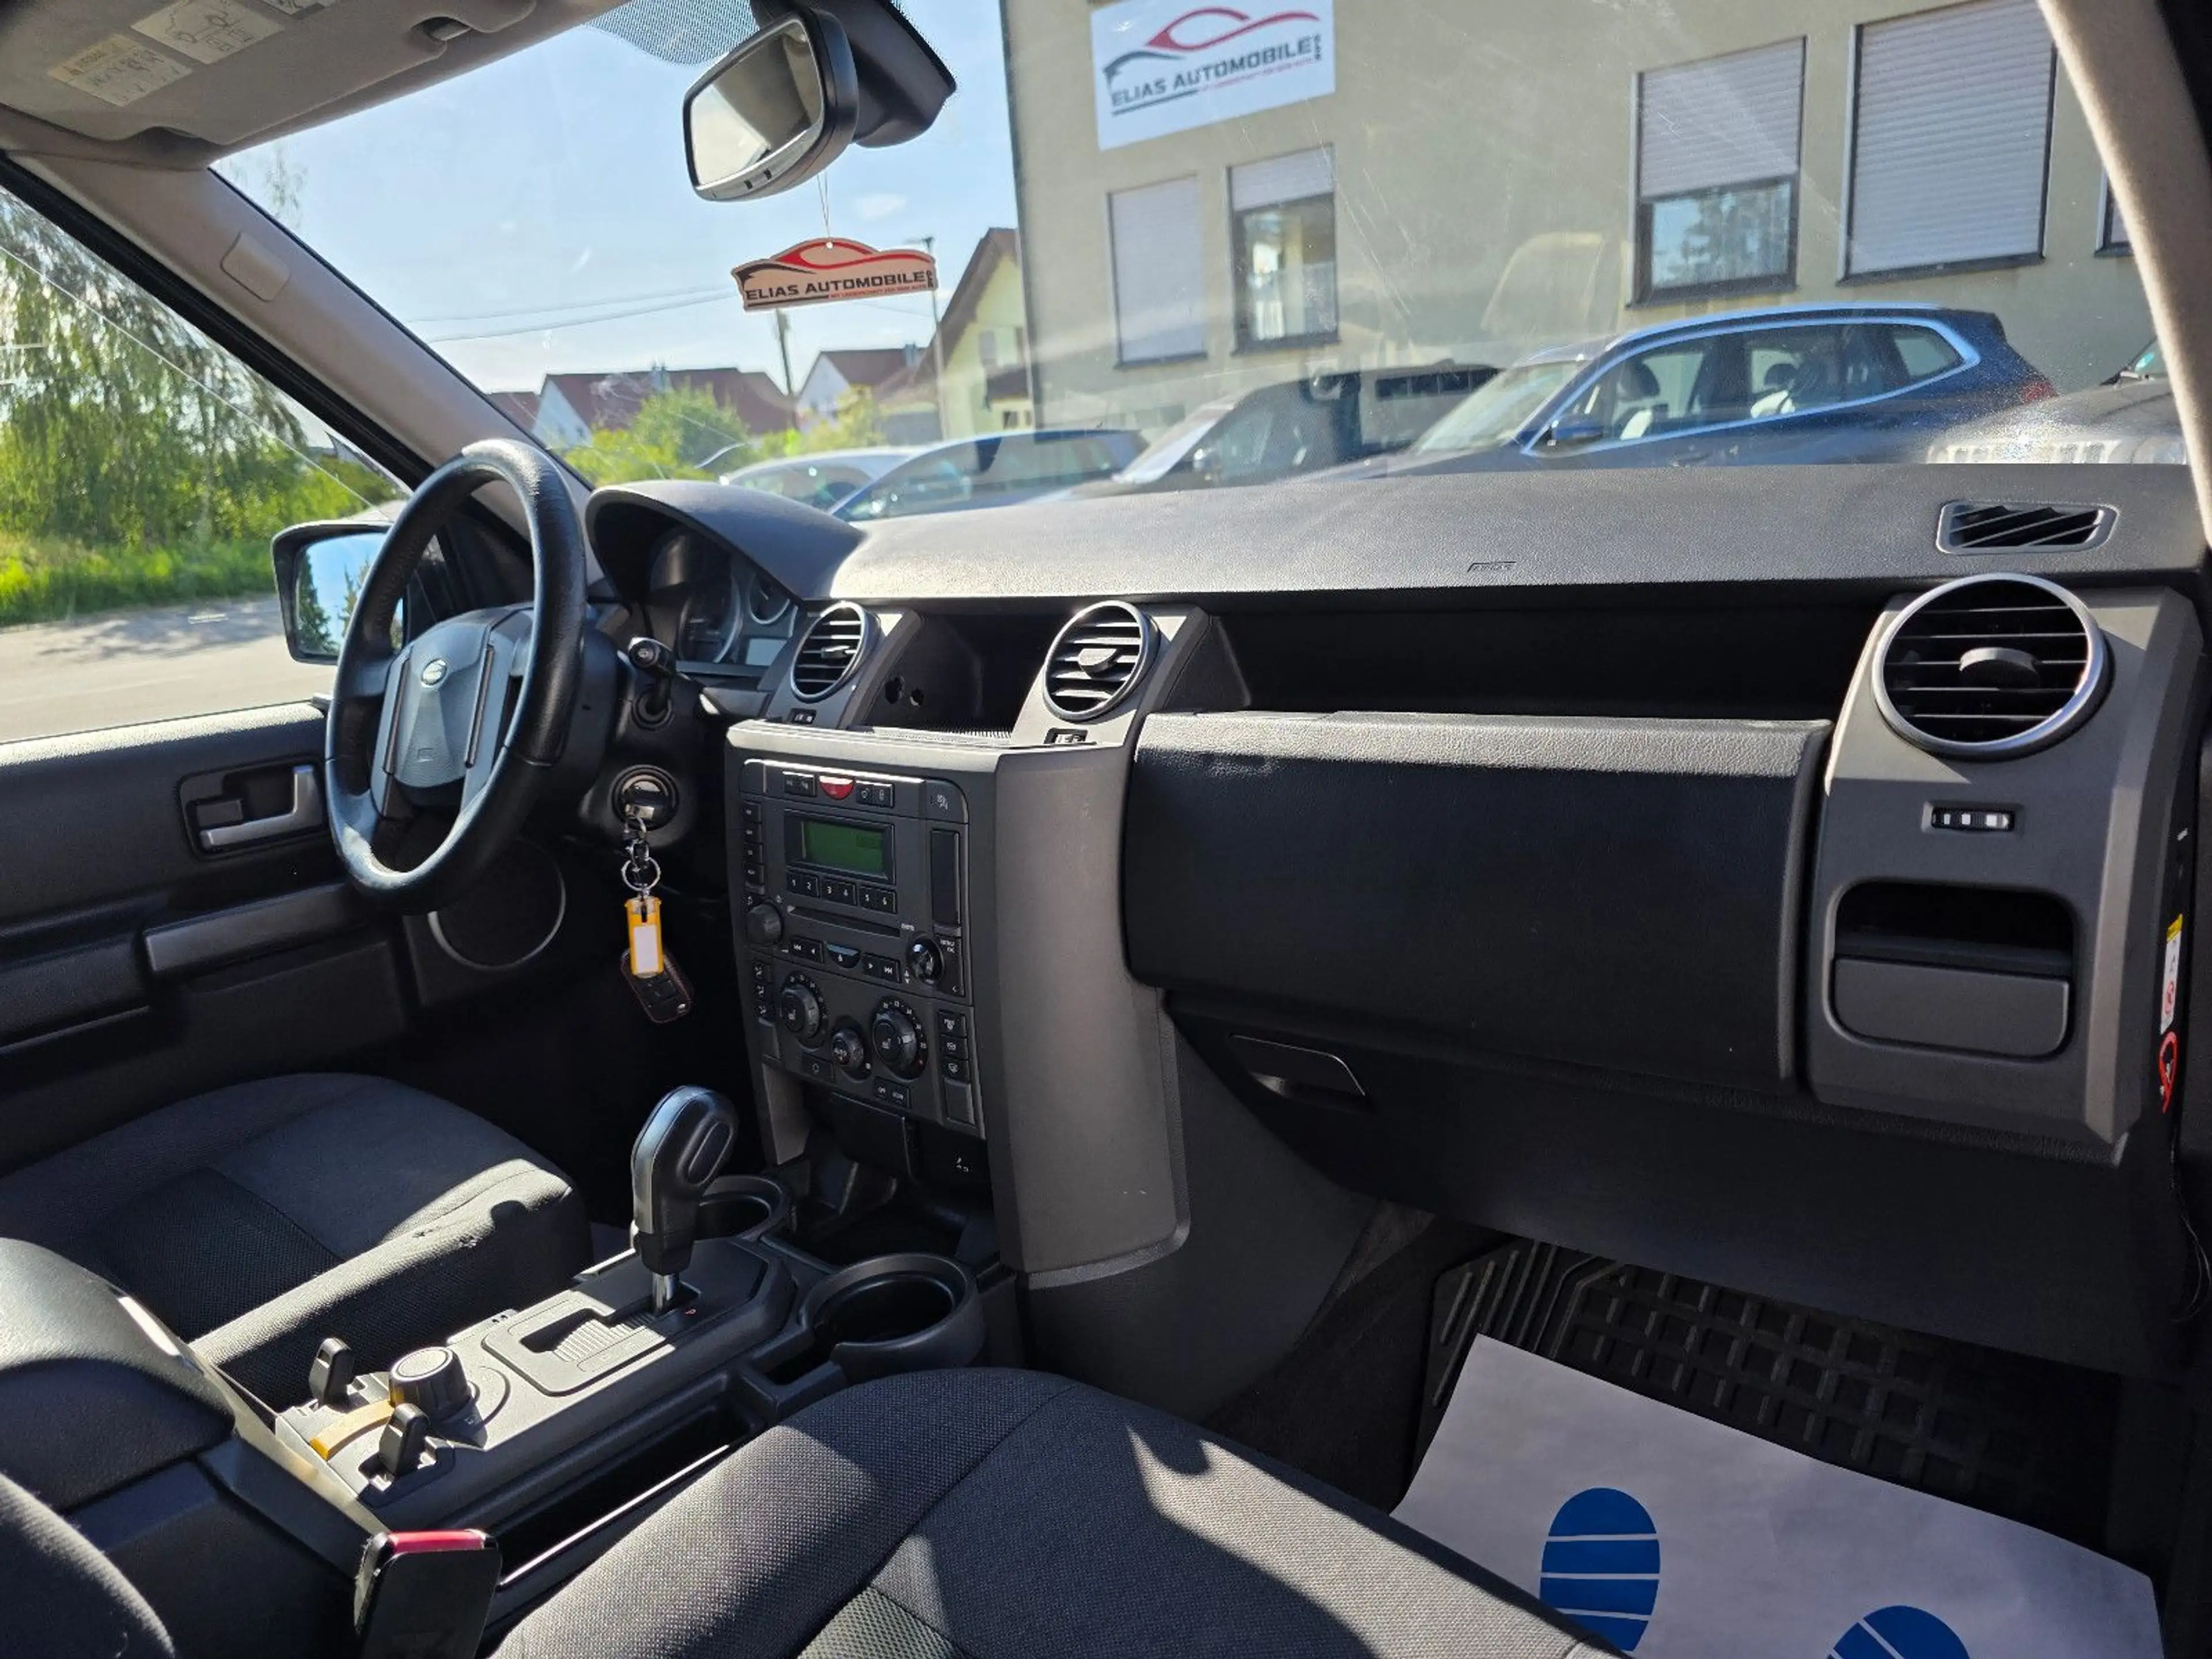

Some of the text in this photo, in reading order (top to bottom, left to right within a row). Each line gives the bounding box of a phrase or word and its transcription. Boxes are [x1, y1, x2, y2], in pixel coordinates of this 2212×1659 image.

[1112, 78, 1166, 107] ELIAS
[1173, 36, 1311, 90] AUTOMOBILE
[745, 284, 800, 301] ELIAS
[805, 271, 926, 294] AUTOMOBILE
[791, 878, 796, 887] 1
[806, 881, 812, 890] 2
[827, 885, 832, 894] 3
[865, 893, 870, 903] 5
[882, 896, 887, 906] 6
